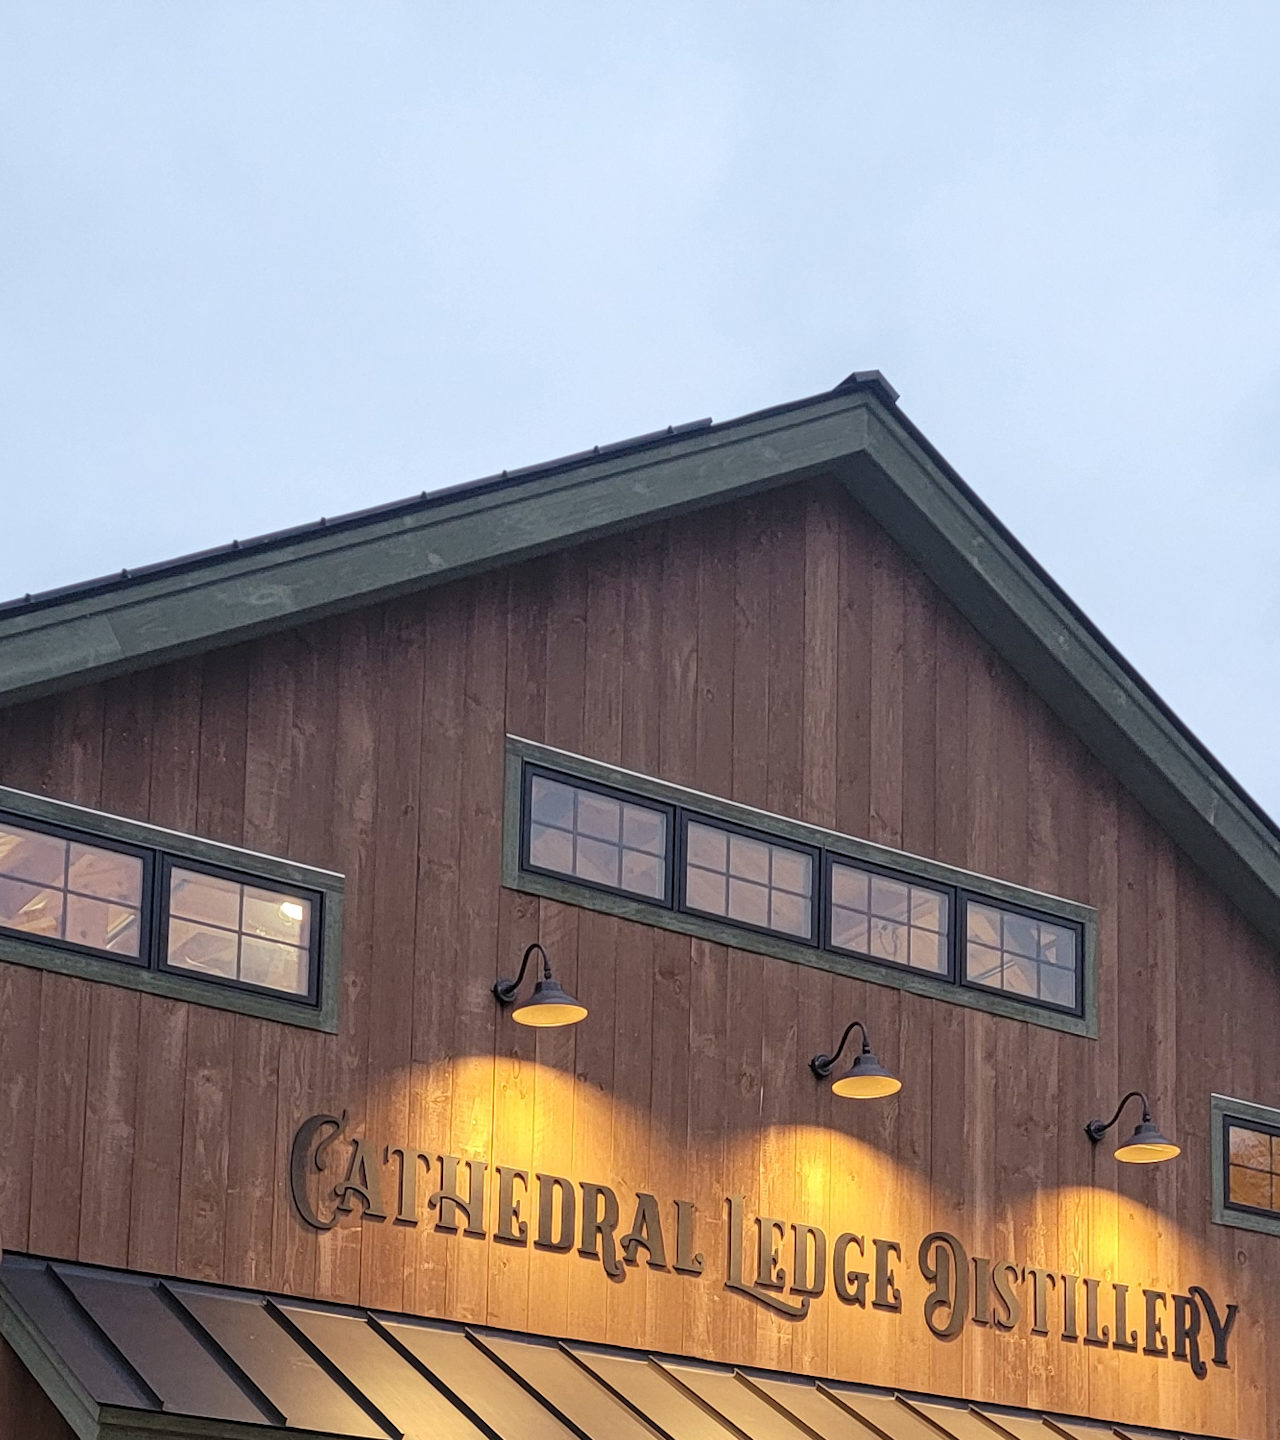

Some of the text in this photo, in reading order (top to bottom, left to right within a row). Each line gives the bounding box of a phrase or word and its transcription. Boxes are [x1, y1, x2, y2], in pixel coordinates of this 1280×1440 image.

[290, 1109, 1239, 1380] CATHEDRAL LEDGE DISTILLERY
